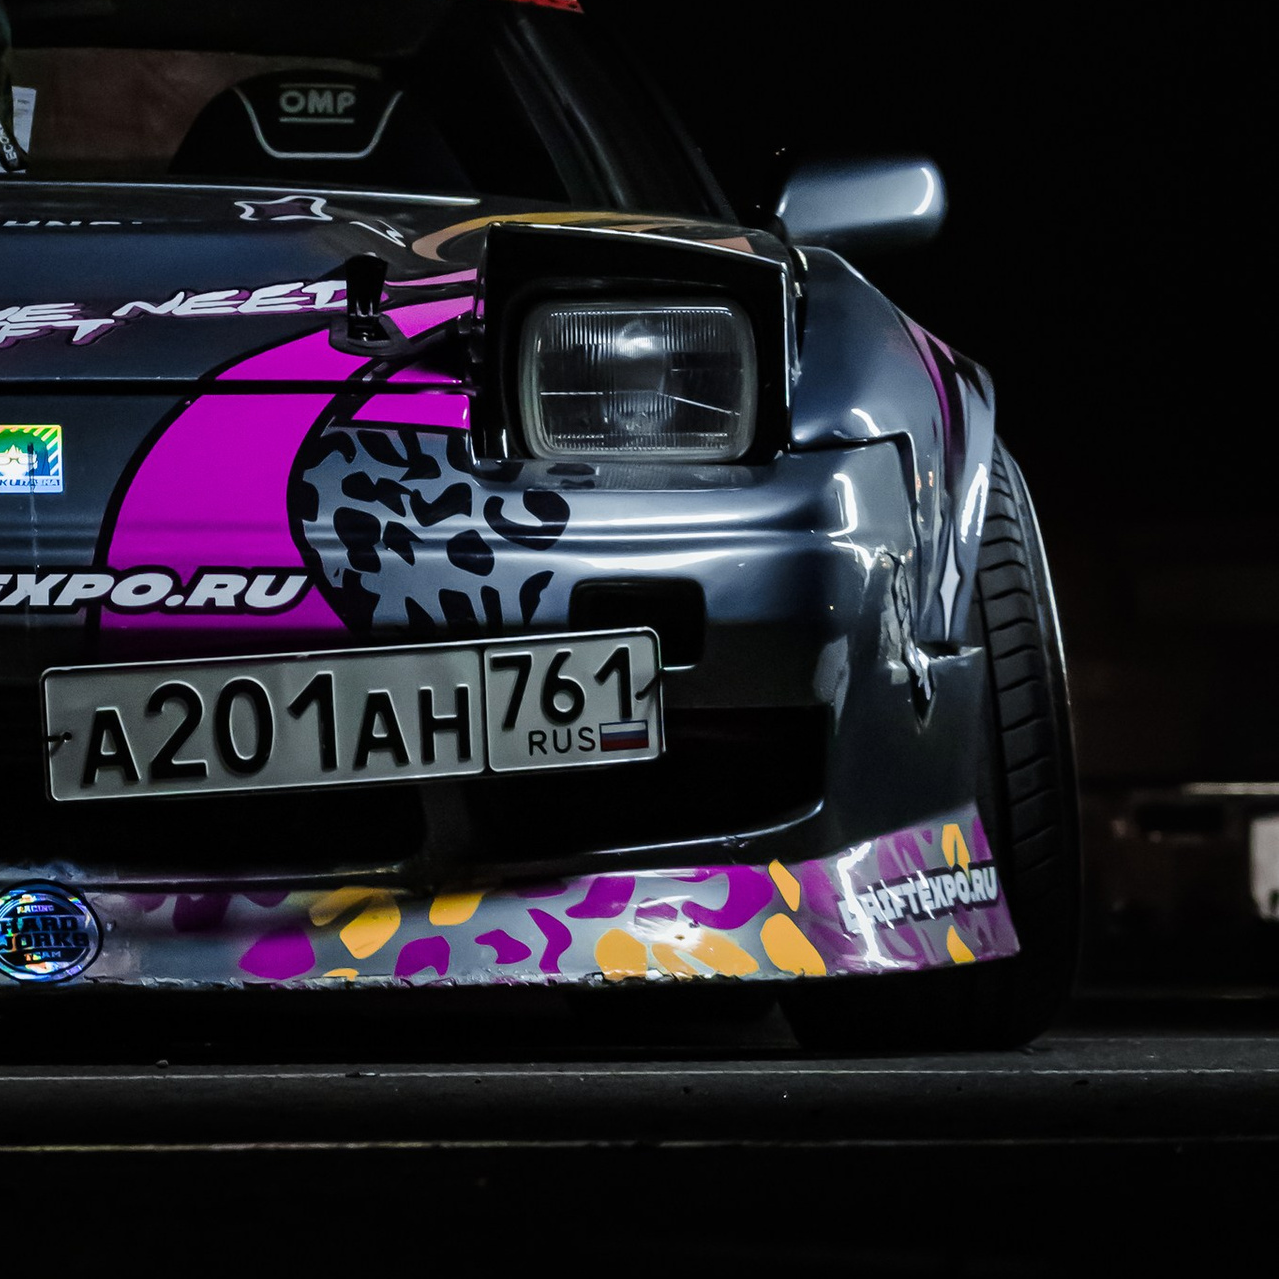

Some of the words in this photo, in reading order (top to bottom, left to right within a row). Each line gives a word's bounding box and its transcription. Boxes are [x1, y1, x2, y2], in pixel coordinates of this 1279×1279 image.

[279, 89, 356, 115] OMP
[79, 671, 472, 790] A201AH
[490, 645, 635, 732] 761
[527, 726, 597, 756] RUS
[0, 915, 79, 935] HARD
[24, 950, 62, 961] TEAM
